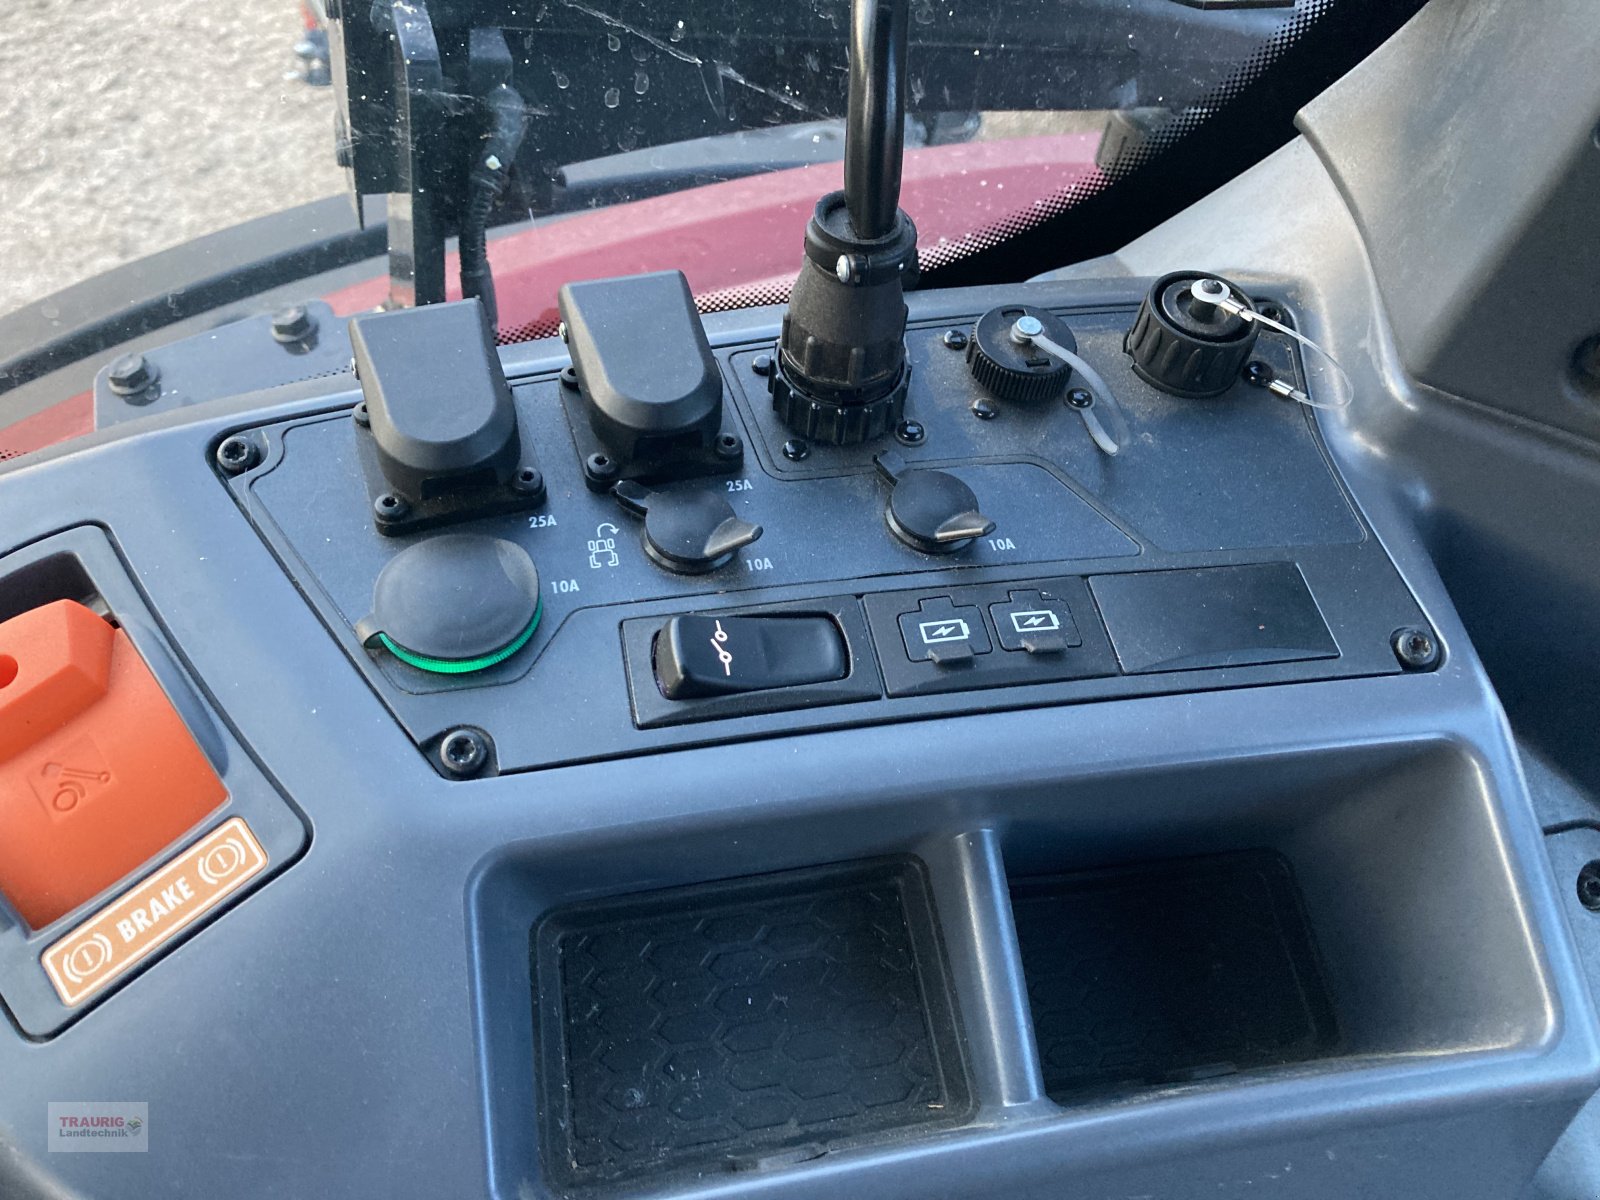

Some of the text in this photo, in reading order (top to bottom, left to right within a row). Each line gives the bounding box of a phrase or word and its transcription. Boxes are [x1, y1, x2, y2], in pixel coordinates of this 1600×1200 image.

[726, 479, 753, 492] 25A
[528, 515, 557, 528] 25A
[989, 538, 1016, 551] 10A
[746, 557, 773, 571] 10A
[550, 580, 580, 593] 10A
[116, 877, 195, 943] BRAKE
